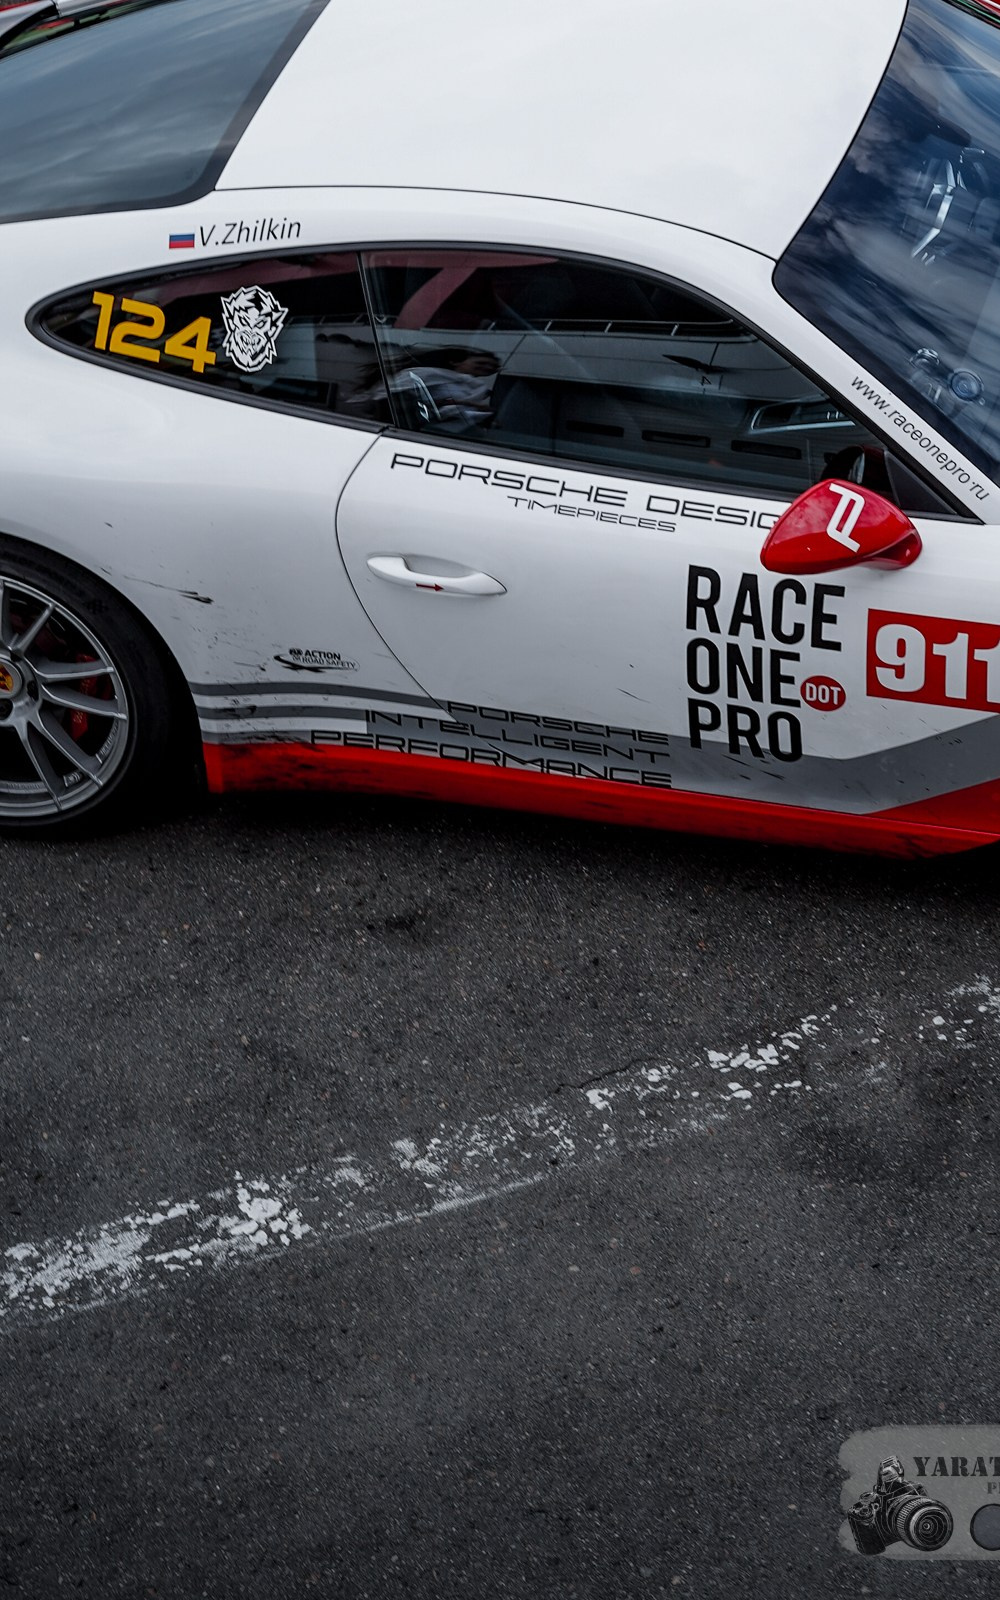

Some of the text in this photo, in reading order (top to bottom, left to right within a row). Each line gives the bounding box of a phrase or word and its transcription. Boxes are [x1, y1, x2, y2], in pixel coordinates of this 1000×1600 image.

[200, 217, 302, 247] V.Zhilkin
[92, 290, 216, 373] 124
[390, 453, 781, 531] PORSCHE DESIG
[506, 495, 677, 533] TIMEPIECES
[686, 564, 845, 652] RACE
[305, 649, 341, 661] ACTION
[327, 659, 356, 669] SAFETY
[686, 637, 842, 708] ONE DOT
[365, 709, 671, 763] INTELLIGENT
[447, 701, 669, 746] PORSCHE
[687, 697, 803, 763] PRO
[310, 730, 672, 789] PERFORMANCE
